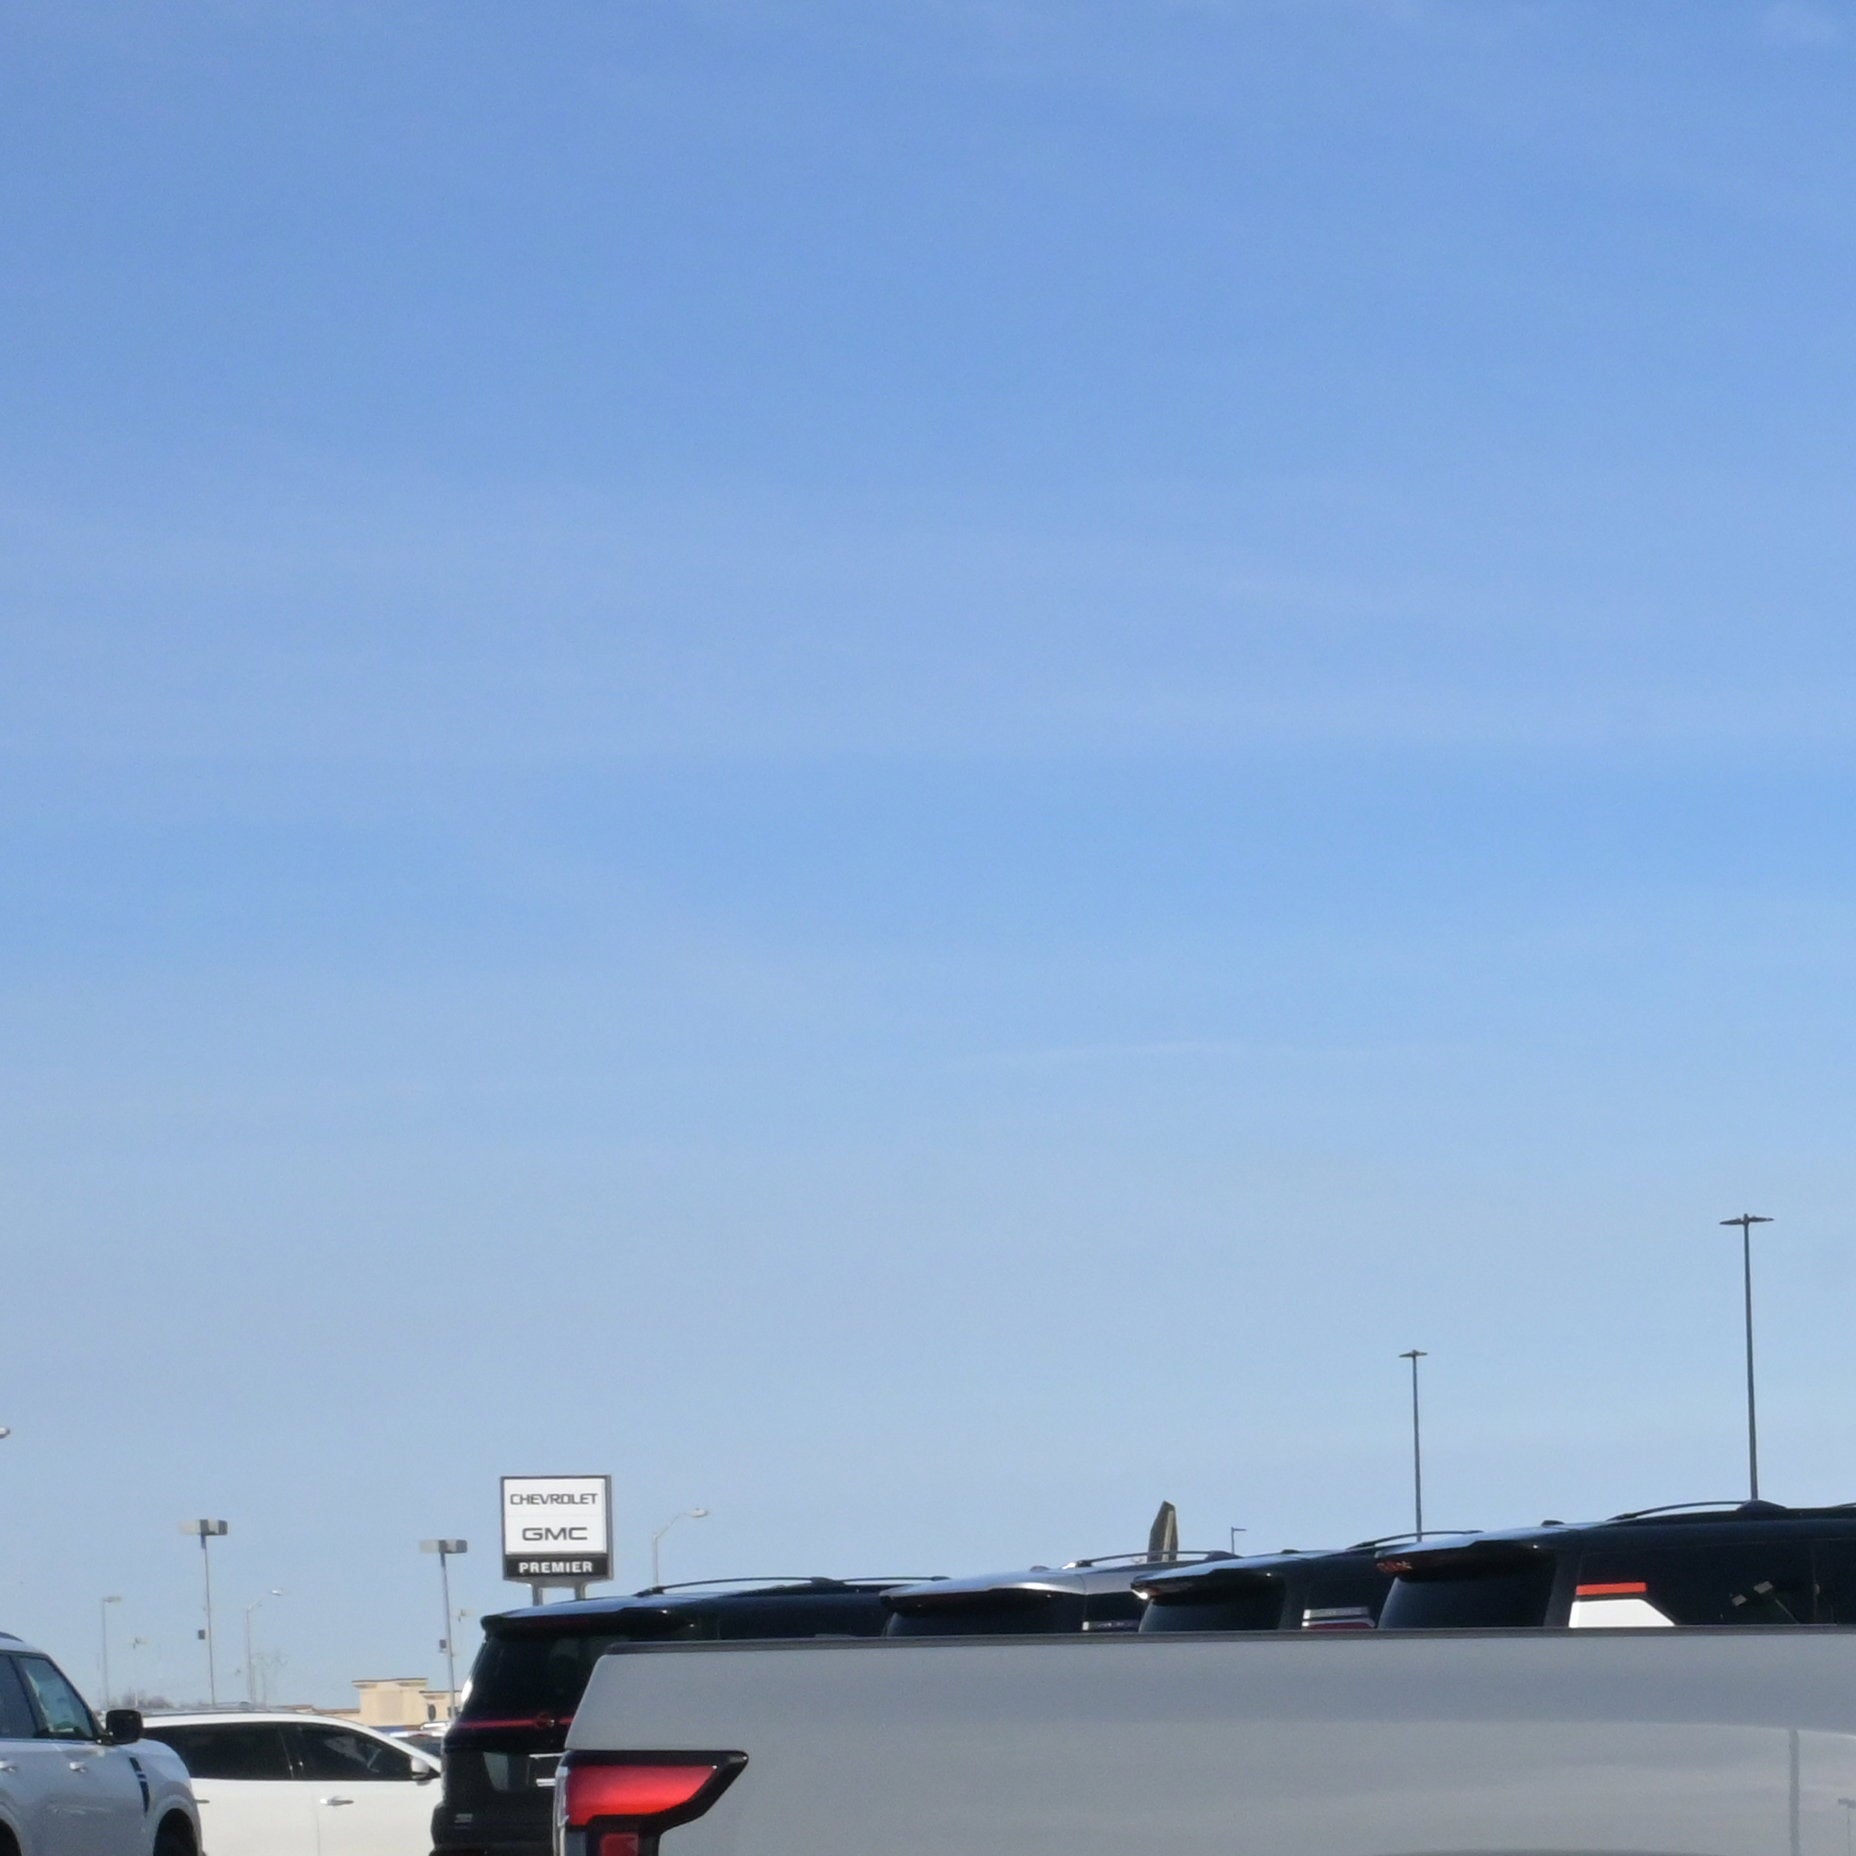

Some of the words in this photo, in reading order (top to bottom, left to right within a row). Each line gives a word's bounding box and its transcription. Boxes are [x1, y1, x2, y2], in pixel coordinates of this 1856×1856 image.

[510, 1493, 598, 1505] CHEVROLET
[522, 1527, 588, 1541] GMC
[519, 1561, 593, 1573] PREMIER
